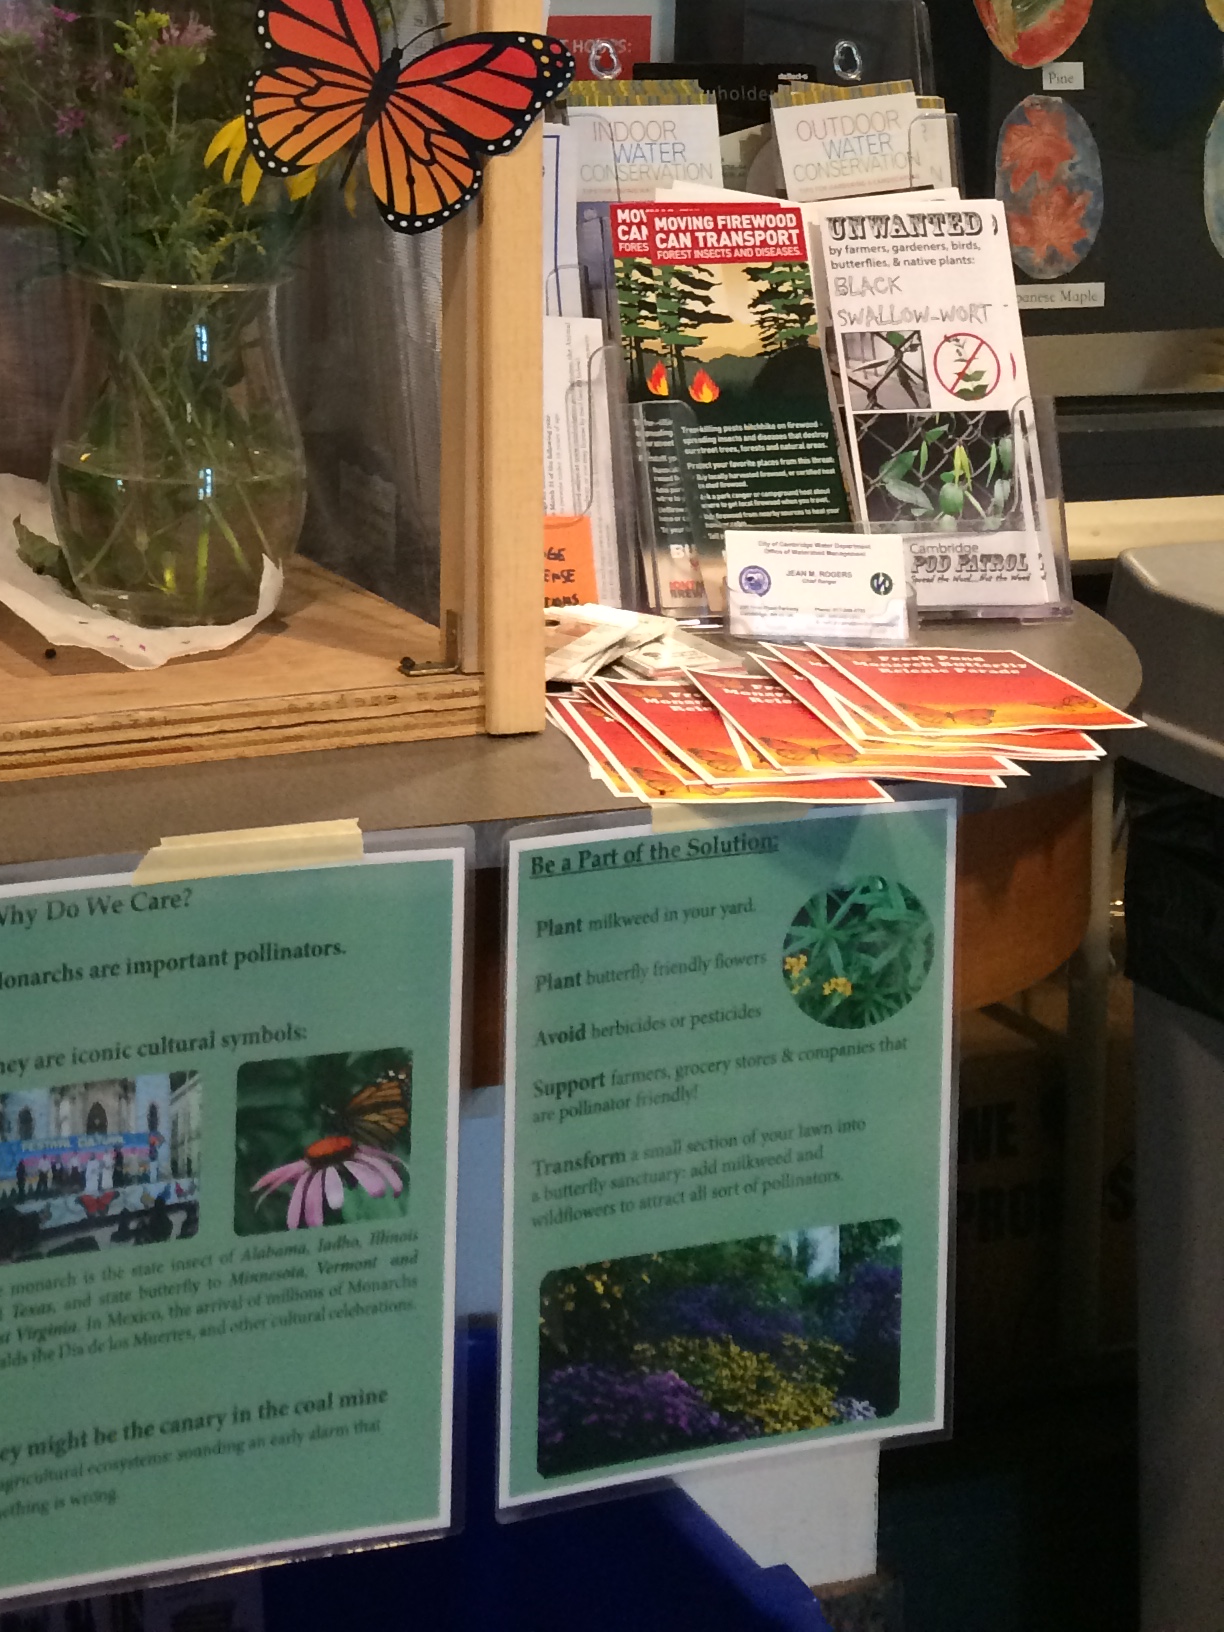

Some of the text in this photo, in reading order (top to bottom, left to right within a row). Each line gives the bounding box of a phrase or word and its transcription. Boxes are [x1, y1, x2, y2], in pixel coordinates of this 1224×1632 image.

[1047, 71, 1073, 84] Pine
[593, 120, 676, 142] INDOOR
[796, 109, 903, 142] OUTDOOR
[615, 143, 687, 164] WATER
[821, 132, 894, 160] WATER
[580, 162, 713, 183] CONSERVATION
[793, 149, 921, 183] CONSERVATION
[654, 213, 797, 232] MOVING FIREWOOD
[825, 211, 984, 241] UNWANTED
[654, 229, 800, 249] CAN TRANSPORT
[829, 239, 982, 257] by farmers, gardeners, birds,
[657, 245, 803, 261] FOREST INSECTS AND DISEASES.
[831, 255, 976, 270] butterflies, & native plants:
[833, 275, 903, 298] BLACK
[909, 543, 979, 555] Cambridge
[910, 553, 1029, 574] POD PATROL
[819, 571, 853, 579] ROGERS
[852, 660, 1028, 669] Monarch Butterfly
[954, 667, 1020, 675] Parade
[531, 833, 780, 877] Be a Part of the Solution:
[46, 900, 79, 920] Do
[86, 895, 123, 915] We
[130, 887, 192, 911] Care?
[536, 896, 756, 937] Plant milkweed in your yard.
[89, 963, 120, 979] are
[126, 949, 228, 978] important
[233, 942, 346, 969] pollinators.
[33, 1053, 65, 1069] are
[71, 1042, 131, 1064] iconic
[136, 1030, 215, 1057] cultural
[220, 1022, 306, 1051] symbols:
